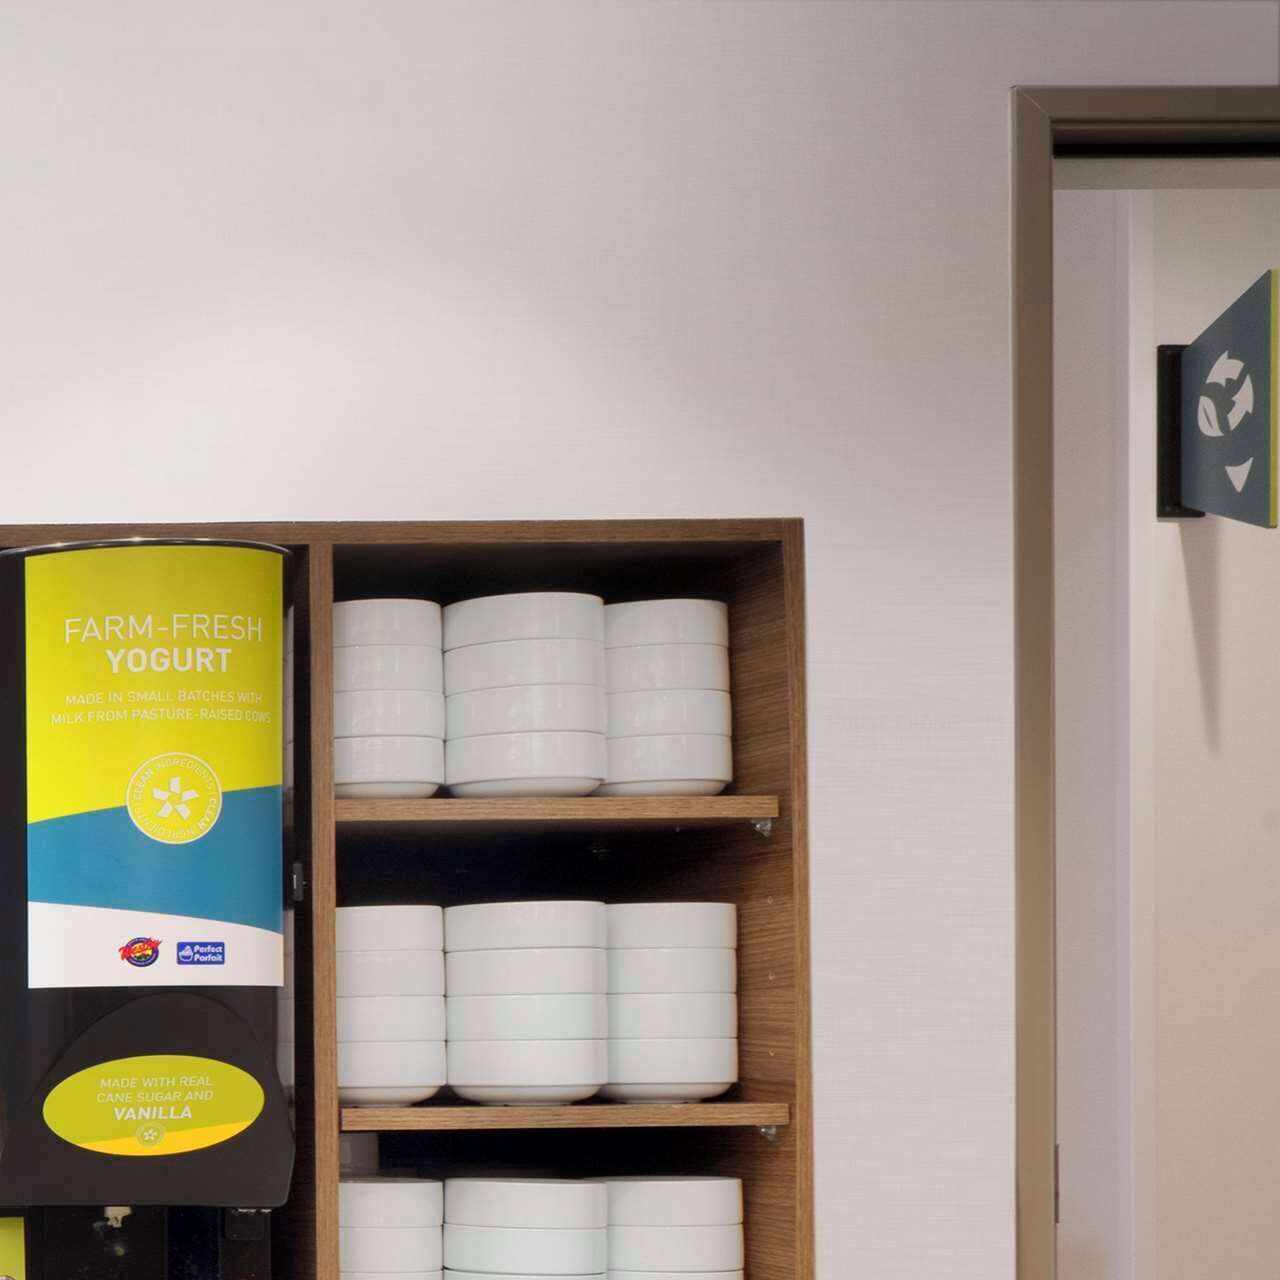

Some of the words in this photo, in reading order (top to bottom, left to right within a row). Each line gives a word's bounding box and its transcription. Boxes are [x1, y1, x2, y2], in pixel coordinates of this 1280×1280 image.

[64, 614, 262, 644] FARM-FRESH
[105, 648, 232, 674] YOGURT
[65, 693, 103, 705] MADE
[108, 692, 123, 703] IN
[127, 691, 174, 703] SMALL
[178, 690, 234, 702] BATCHES
[237, 692, 262, 704] WITH
[50, 712, 85, 725] MILK
[88, 710, 127, 722] FROM
[245, 711, 271, 723] COWS
[194, 944, 223, 953] Perfect
[194, 953, 223, 962] Parfait
[101, 1077, 138, 1089] MADE
[141, 1076, 175, 1088] WITH
[179, 1075, 214, 1087] REAL
[97, 1092, 133, 1104] CANE
[136, 1090, 182, 1102] SUGAR
[185, 1090, 214, 1101] AND
[113, 1106, 193, 1121] VANILLA
